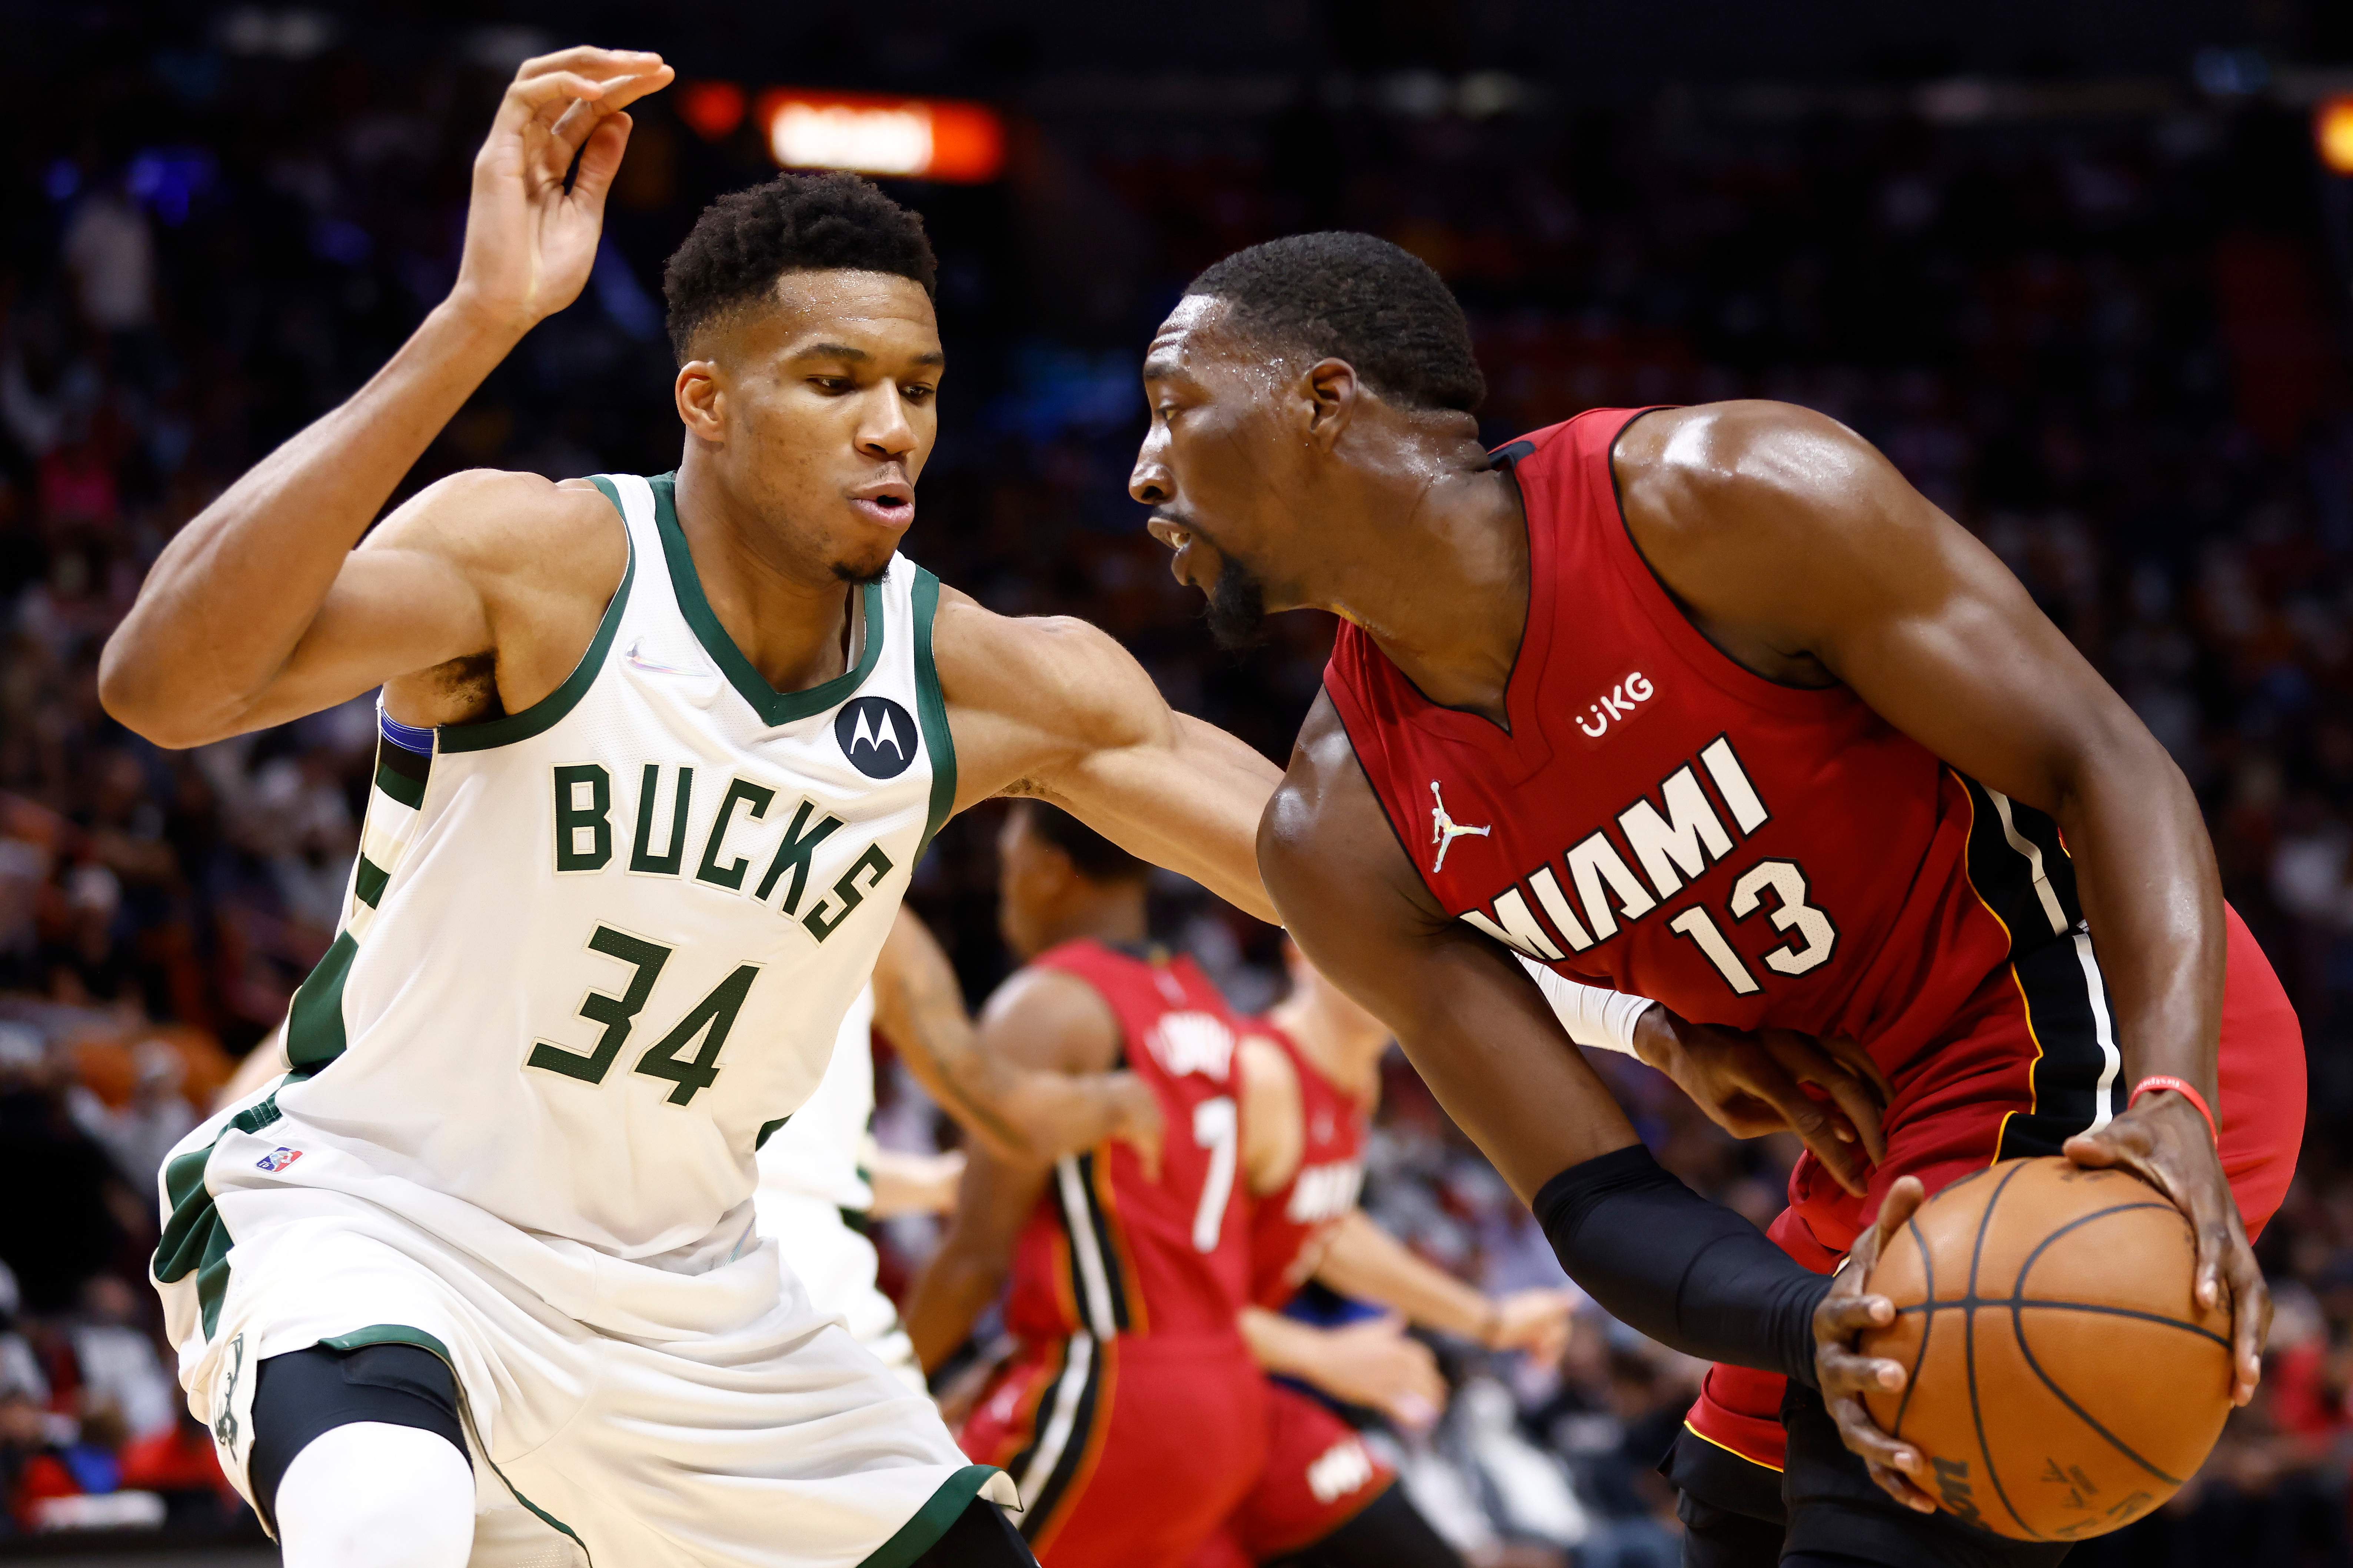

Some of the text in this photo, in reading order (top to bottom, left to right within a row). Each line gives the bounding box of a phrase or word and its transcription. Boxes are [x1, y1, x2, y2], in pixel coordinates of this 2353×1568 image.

[552, 762, 895, 945] BUCKS
[1459, 736, 1768, 961] MIAMI
[1669, 860, 1836, 995] 13
[524, 922, 762, 1108] 34
[1191, 1095, 1239, 1253] 7
